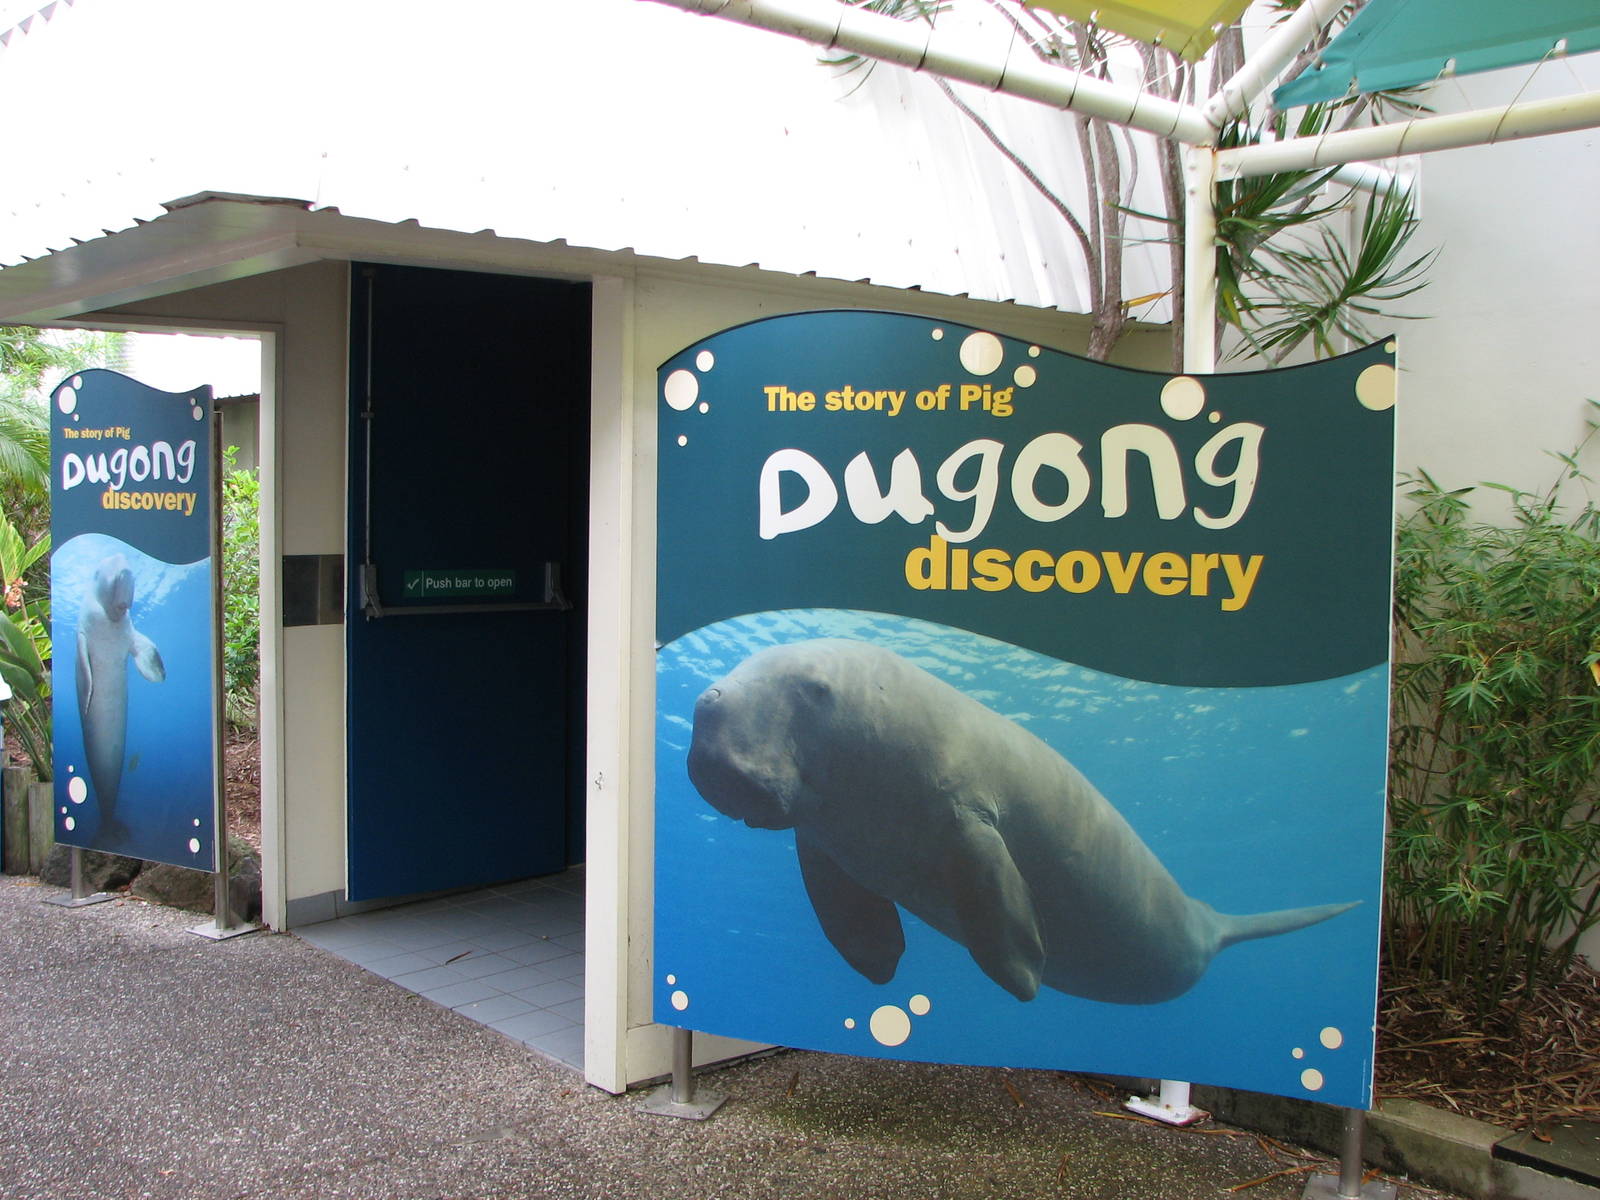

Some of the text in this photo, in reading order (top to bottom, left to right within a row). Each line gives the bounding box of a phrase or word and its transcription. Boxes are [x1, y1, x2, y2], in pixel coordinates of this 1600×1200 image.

[764, 384, 1014, 416] The story of Pig
[63, 426, 131, 440] The story of Pig
[62, 440, 196, 491] Dugong
[759, 422, 1265, 543] Dugong
[102, 487, 197, 516] discovery
[425, 577, 513, 590] Push bar to open
[905, 534, 1264, 611] discovery
